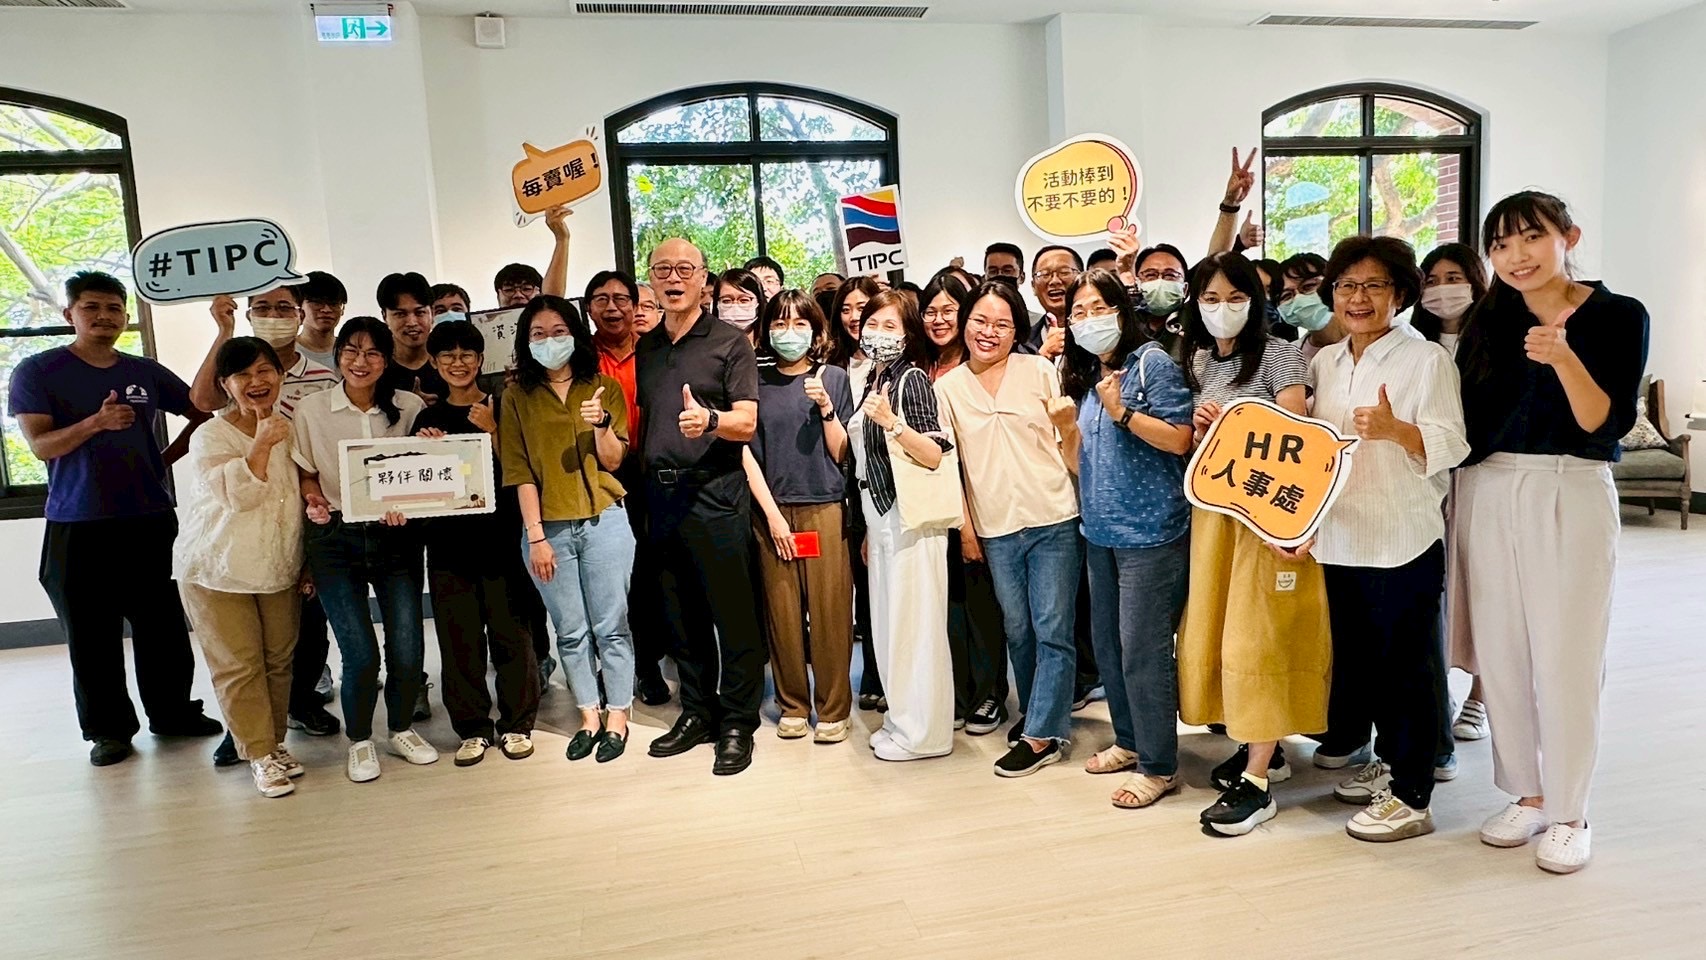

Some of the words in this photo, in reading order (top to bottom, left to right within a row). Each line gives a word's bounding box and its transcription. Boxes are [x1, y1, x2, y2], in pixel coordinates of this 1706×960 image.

[1043, 164, 1114, 189] 活動棒到
[1027, 186, 1127, 213] 不要不要的！
[149, 240, 278, 277] #TIPC
[850, 249, 904, 272] TIPC
[1244, 431, 1305, 464] HR
[377, 467, 454, 485] 夥伴關懷
[1211, 459, 1305, 515] 人事處
